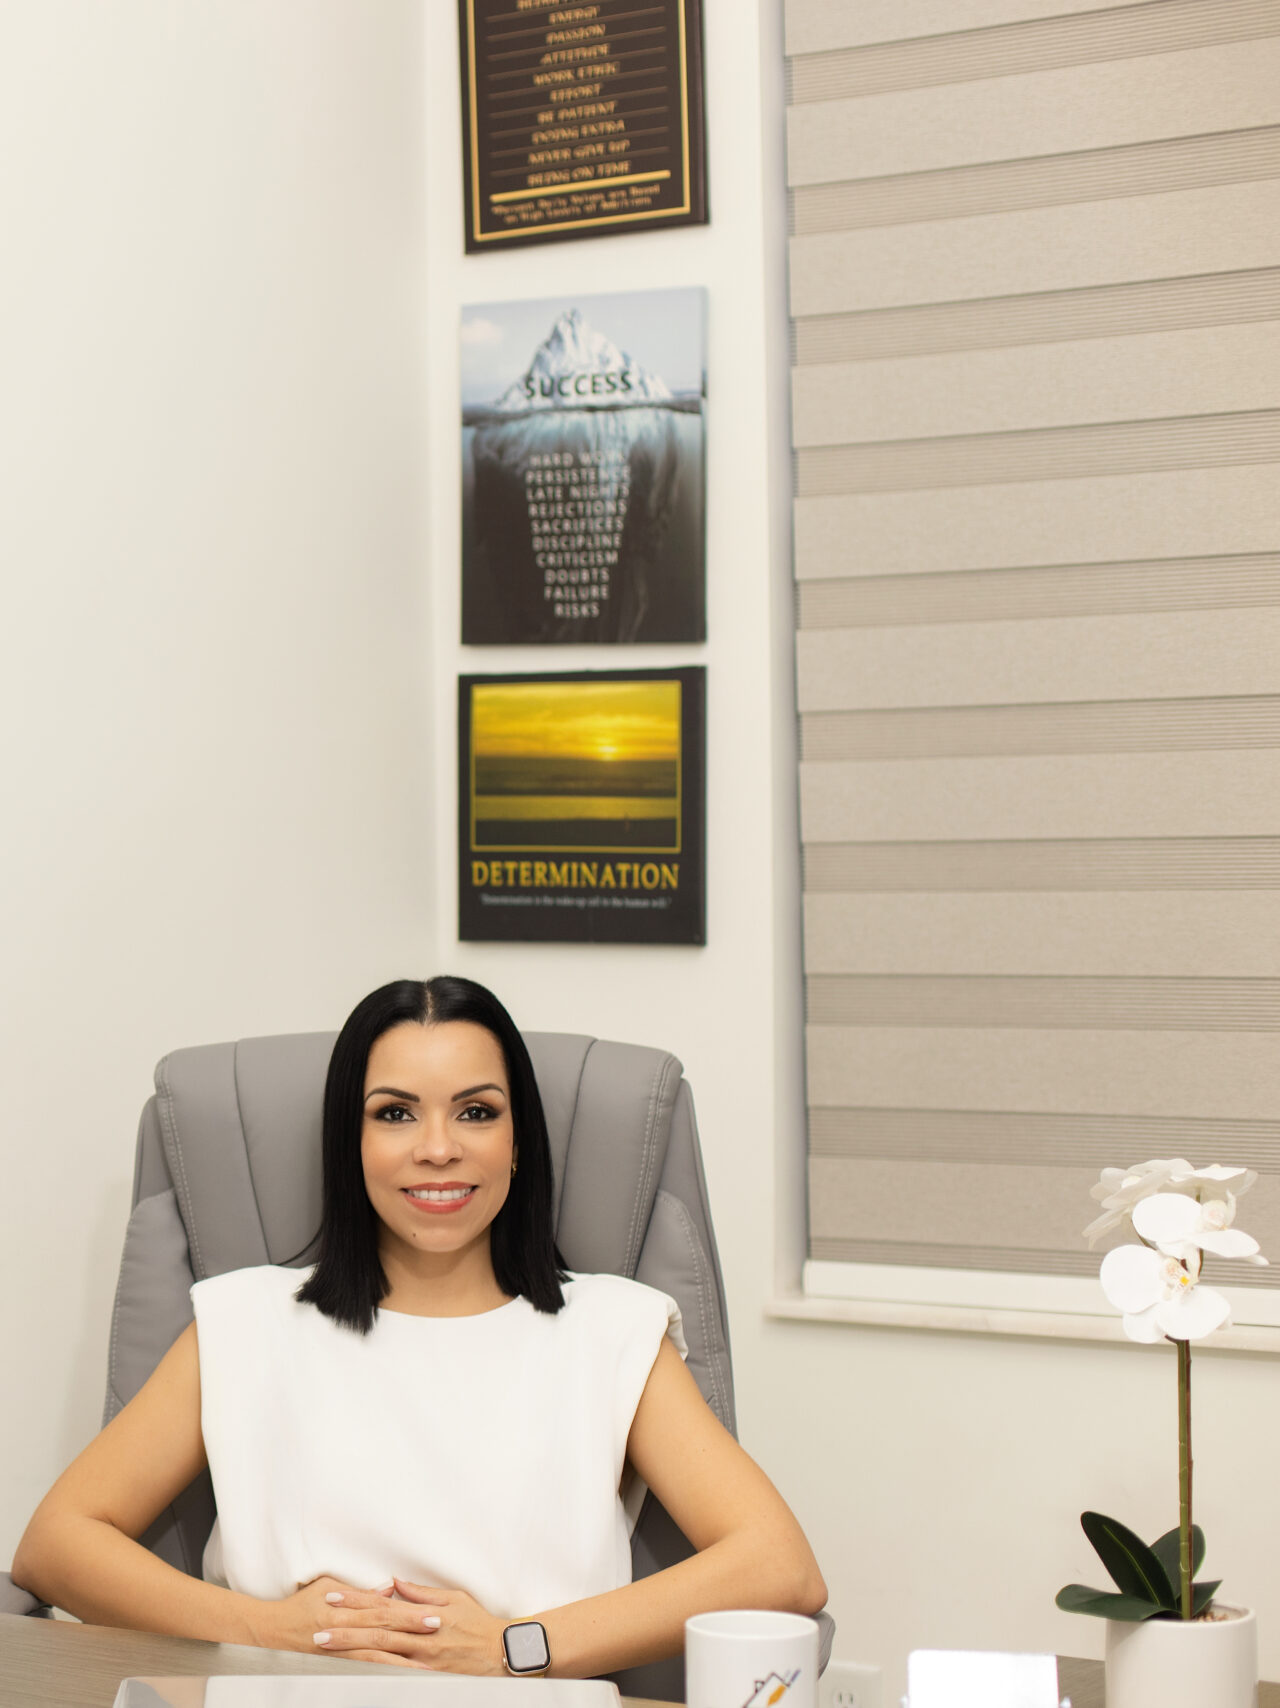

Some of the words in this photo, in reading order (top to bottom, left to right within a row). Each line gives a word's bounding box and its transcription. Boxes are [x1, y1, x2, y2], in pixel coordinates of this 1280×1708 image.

[548, 5, 600, 24] ENERGY
[546, 23, 606, 45] PASSION
[539, 42, 610, 64] ATTITUDE
[533, 69, 575, 86] WORK
[576, 61, 619, 79] ETHIC
[549, 82, 602, 103] EFFORT
[537, 109, 554, 124] BE
[557, 100, 617, 121] PATIENT
[580, 119, 625, 137] EXTRA
[527, 147, 571, 164] NEVER
[572, 142, 604, 159] GIVE
[607, 138, 630, 153] UP
[527, 168, 571, 187] BEING
[571, 165, 595, 180] ON
[596, 160, 631, 178] TIME
[524, 370, 632, 399] SUCCESS
[530, 452, 574, 467] HARD
[525, 465, 631, 485] PERSISTENCE
[526, 486, 563, 501] LATE
[570, 482, 629, 499] NIGHTS
[528, 499, 628, 518] REJECTIONS
[531, 516, 624, 535] SACRIFICES
[532, 533, 621, 552] DISCIPLINE
[536, 550, 619, 568] CRITICISM
[544, 567, 610, 585] DOUBTS
[544, 584, 609, 602] FAILURE
[554, 602, 600, 618] RISKS
[471, 861, 680, 889] DETERMINATION
